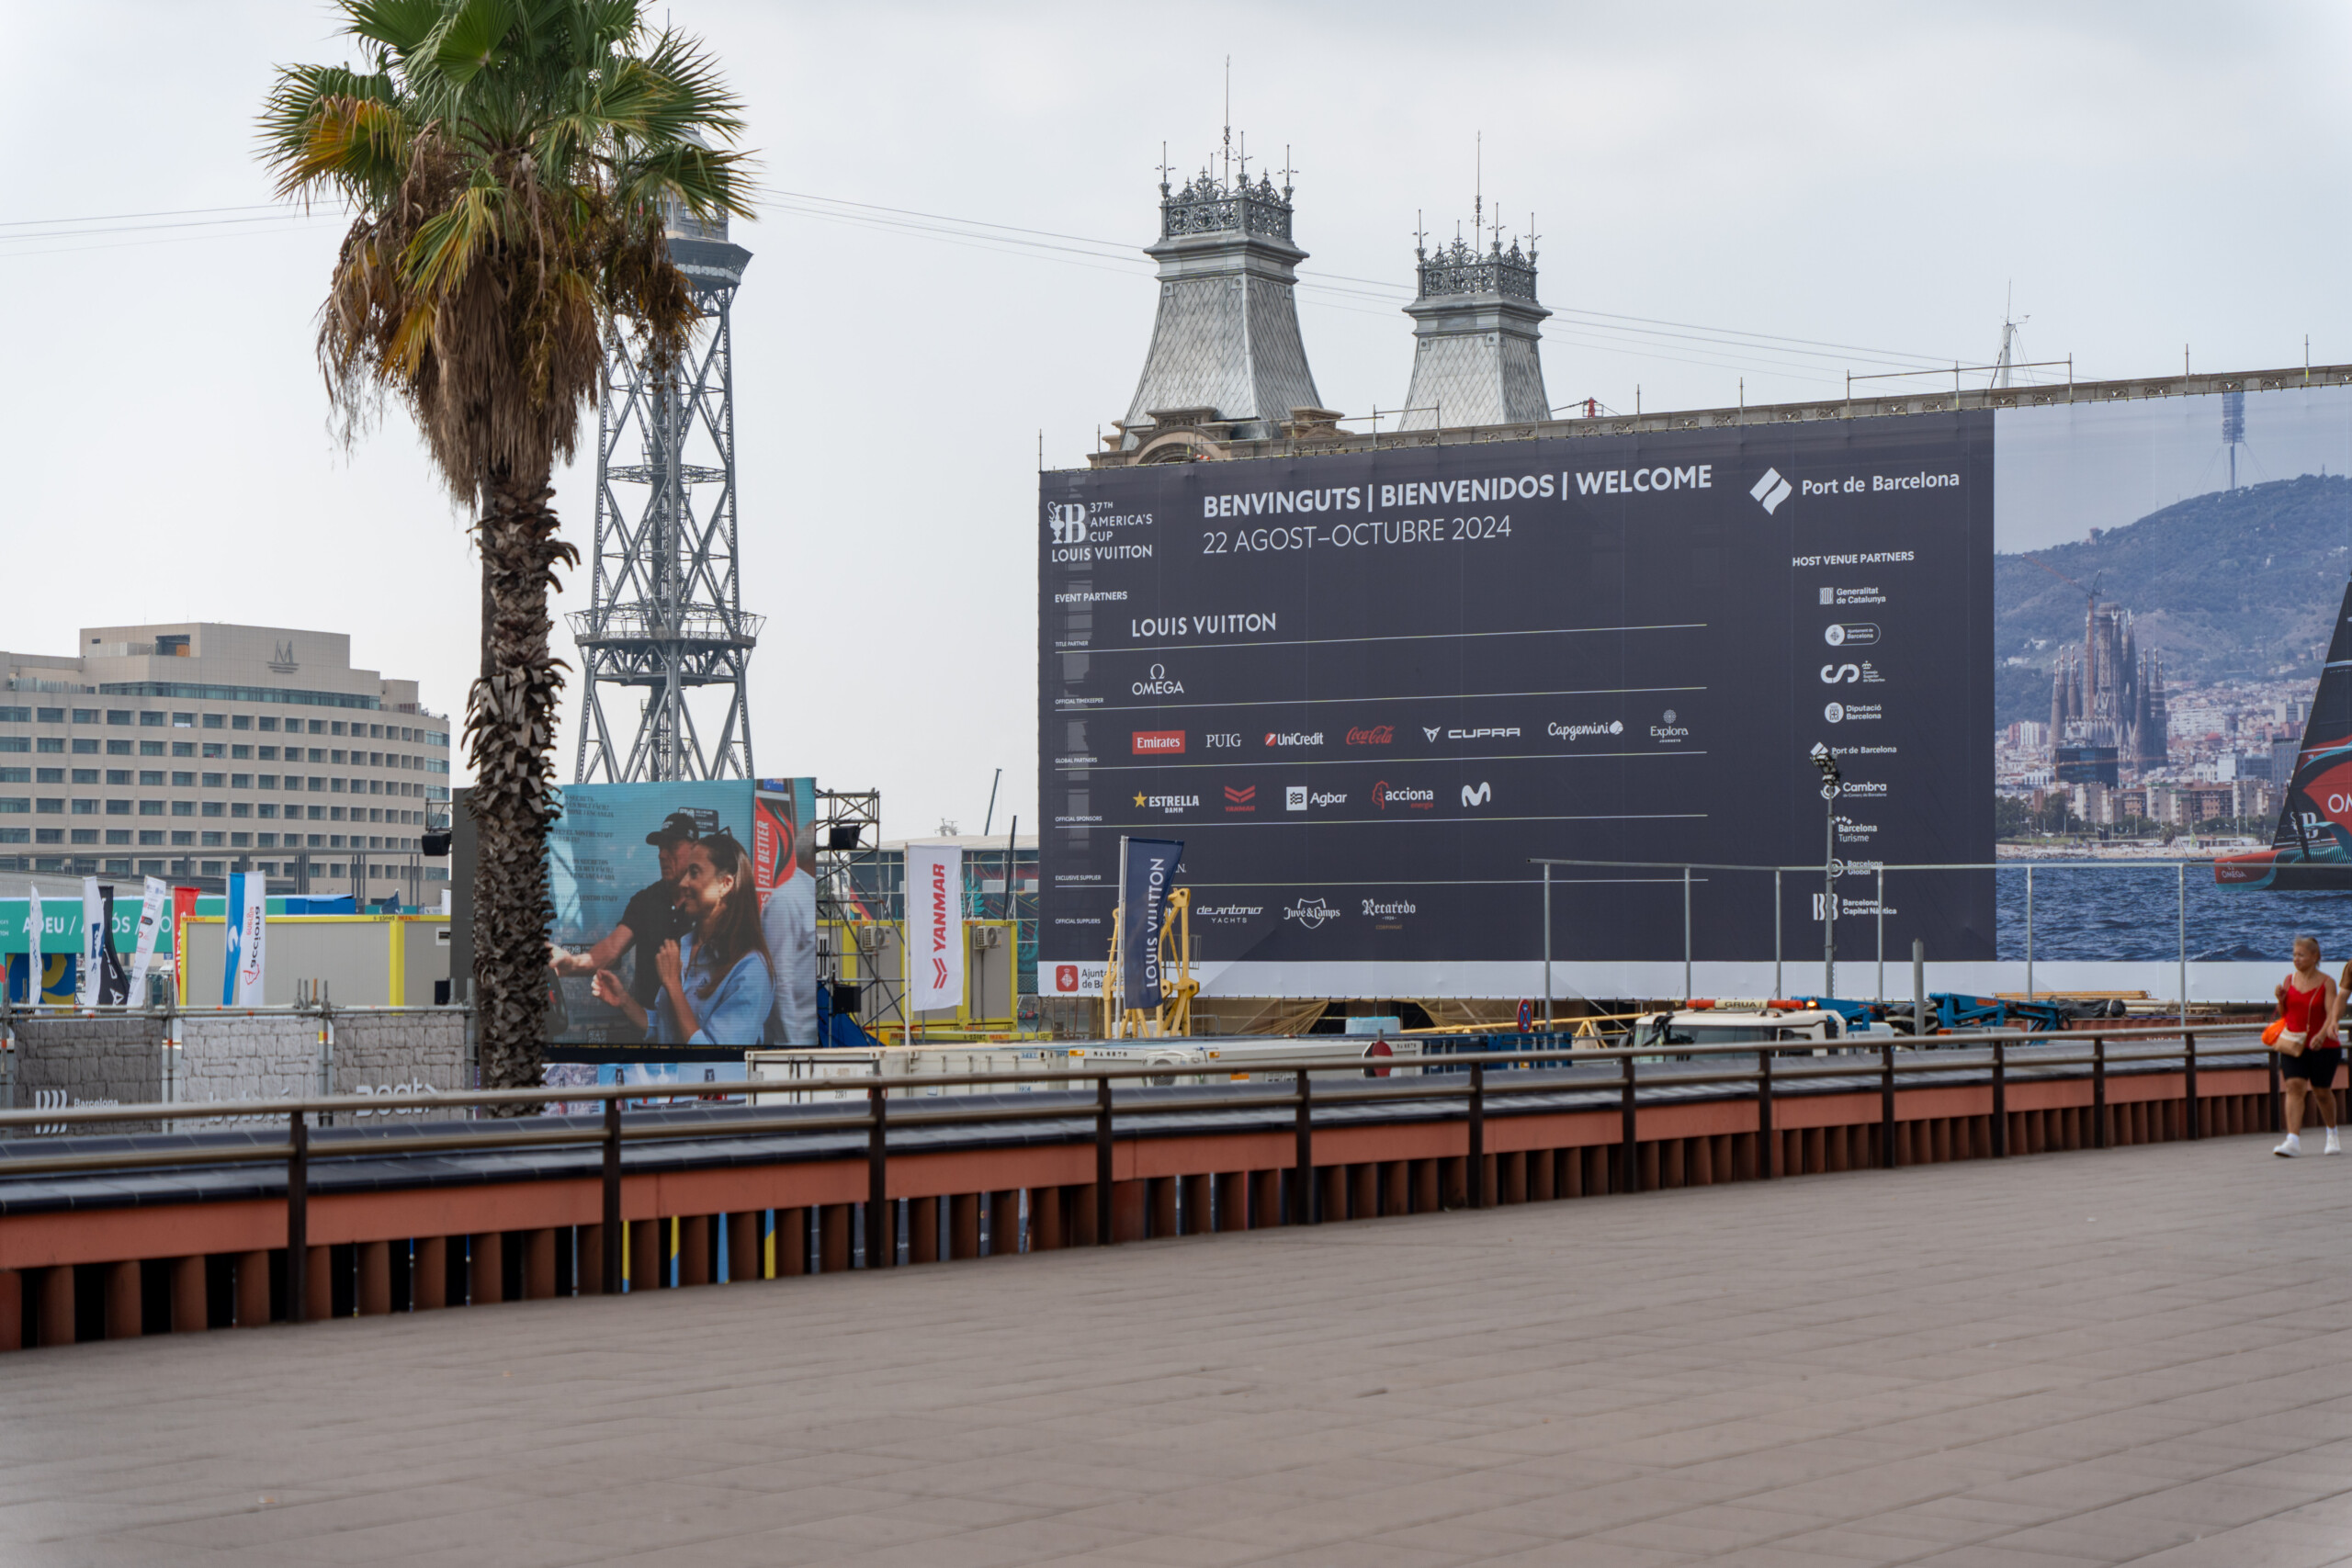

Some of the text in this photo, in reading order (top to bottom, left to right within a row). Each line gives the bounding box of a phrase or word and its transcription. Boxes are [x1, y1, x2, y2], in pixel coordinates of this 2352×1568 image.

[1802, 471, 1960, 495] Port de Barcelona
[1204, 487, 1361, 518] BENVINGUTS
[1381, 474, 1555, 508] BIENVENIDOS
[1575, 464, 1712, 495] WELCOME
[1090, 513, 1153, 527] AMERICA'S
[1090, 531, 1114, 542] CUP
[1203, 532, 1227, 553] 22
[1452, 514, 1511, 540] 2024
[1052, 544, 1153, 562] LOUIS VUITTON
[1792, 551, 1915, 567] HOST VENUE PARTNERS
[1055, 591, 1127, 603] EVENT PARTNERS
[1837, 586, 1879, 596] Generalitat
[1848, 595, 1886, 604] Catalunya
[1132, 613, 1277, 637] LOUIS VUITTON
[1132, 681, 1184, 695] OMEGA
[1846, 704, 1882, 713] Diputació
[1846, 712, 1882, 720] Barcelona
[1448, 728, 1521, 739] CUPRA
[1547, 722, 1609, 741] Capgemini
[1650, 726, 1689, 739] Explora
[1136, 736, 1181, 749] Emirates
[1205, 733, 1242, 748] PUIG
[1277, 732, 1324, 746] UniCredit
[1831, 745, 1897, 755] Port de Barcelona
[1842, 781, 1887, 792] Cambra
[1148, 795, 1200, 807] ESTRELLA
[1309, 792, 1348, 807] Agbar
[1385, 787, 1434, 801] acciona
[1838, 823, 1878, 832] Barcelona
[757, 820, 770, 864] BETTER
[1838, 833, 1870, 842] Turisme
[758, 866, 771, 886] FLY
[933, 863, 945, 953] YANMAR
[1362, 897, 1417, 917] Recaredo
[1842, 898, 1879, 907] Barcelona
[1842, 907, 1869, 917] Capital
[251, 906, 261, 969] acciona
[1146, 937, 1158, 987] LOUIS
[1082, 980, 1092, 988] de
